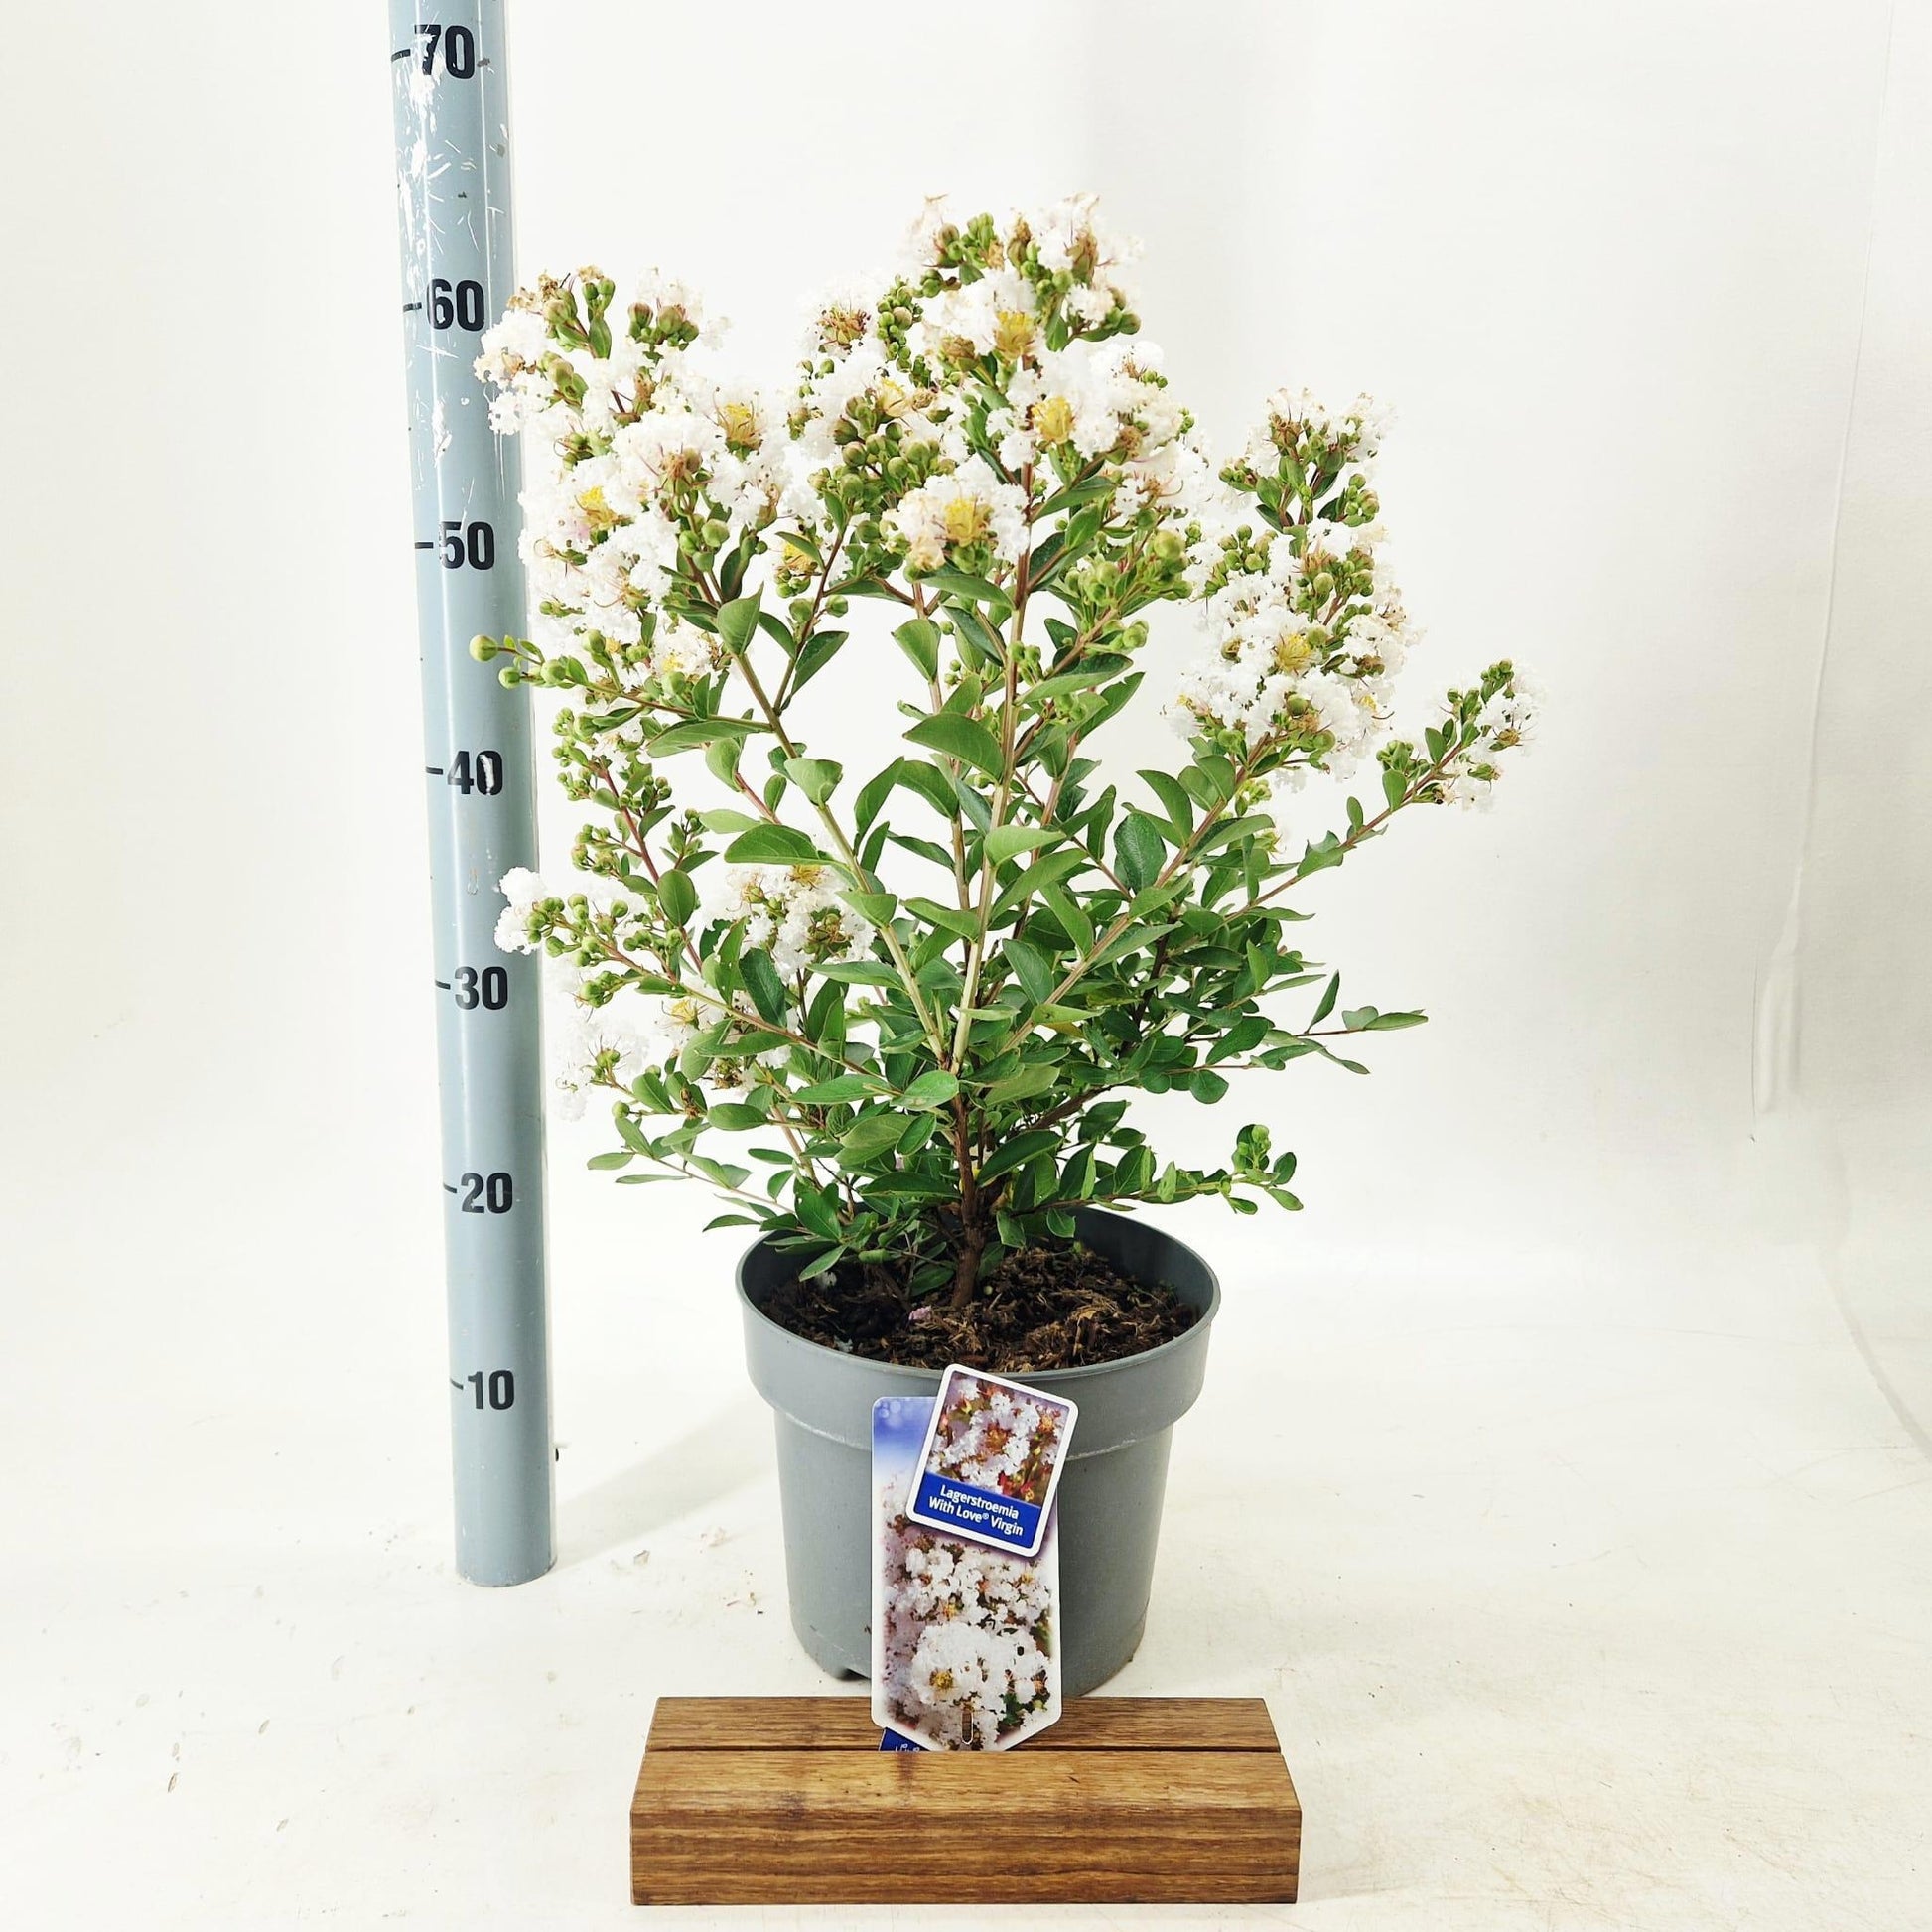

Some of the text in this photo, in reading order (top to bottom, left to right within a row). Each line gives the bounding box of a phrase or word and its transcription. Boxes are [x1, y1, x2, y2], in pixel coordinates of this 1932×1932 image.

[415, 24, 476, 79] 70
[427, 278, 485, 331] 60
[439, 520, 495, 571] 50
[448, 750, 503, 796] 40
[454, 965, 508, 1011] 30
[461, 1172, 513, 1214] 20
[467, 1370, 515, 1411] 10
[928, 1495, 955, 1515] With
[990, 1515, 1024, 1536] Virgin
[939, 1484, 1020, 1520] Lagerstroemia
